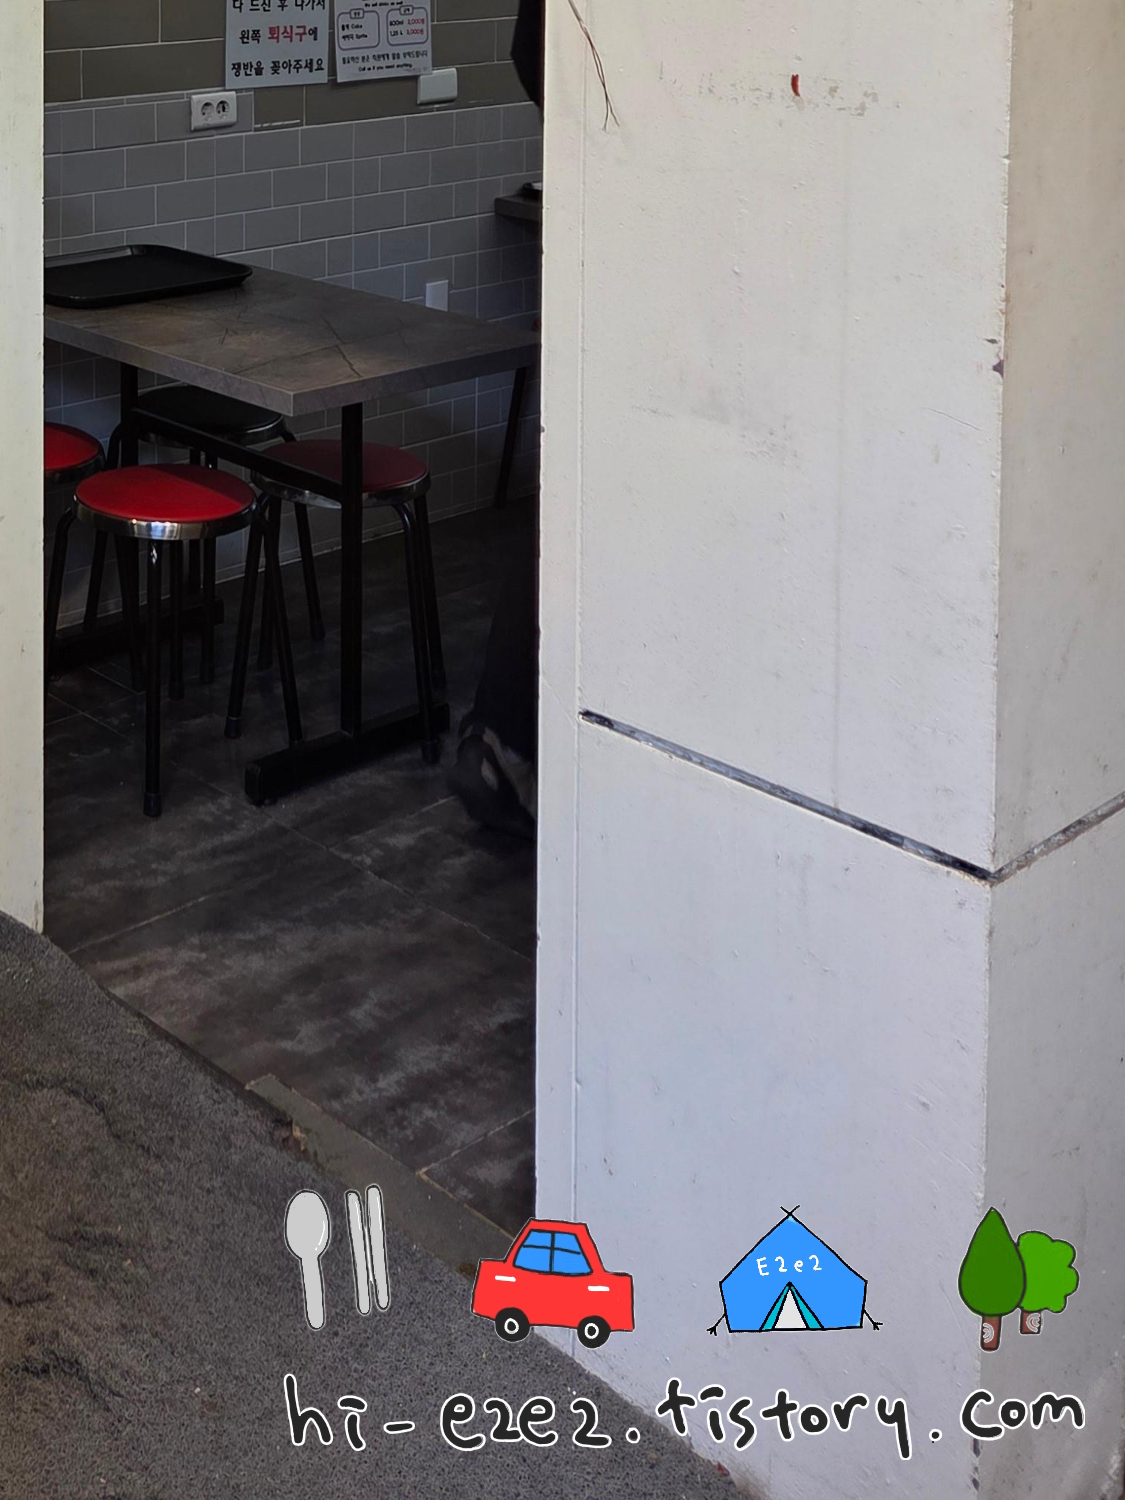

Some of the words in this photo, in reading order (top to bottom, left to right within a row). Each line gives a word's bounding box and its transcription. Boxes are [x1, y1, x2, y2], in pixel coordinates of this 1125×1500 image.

[239, 29, 261, 44] 왼쪽
[268, 25, 318, 43] 퇴식구에
[231, 60, 264, 77] 쟁반을
[270, 57, 324, 75] 꽂아주세요
